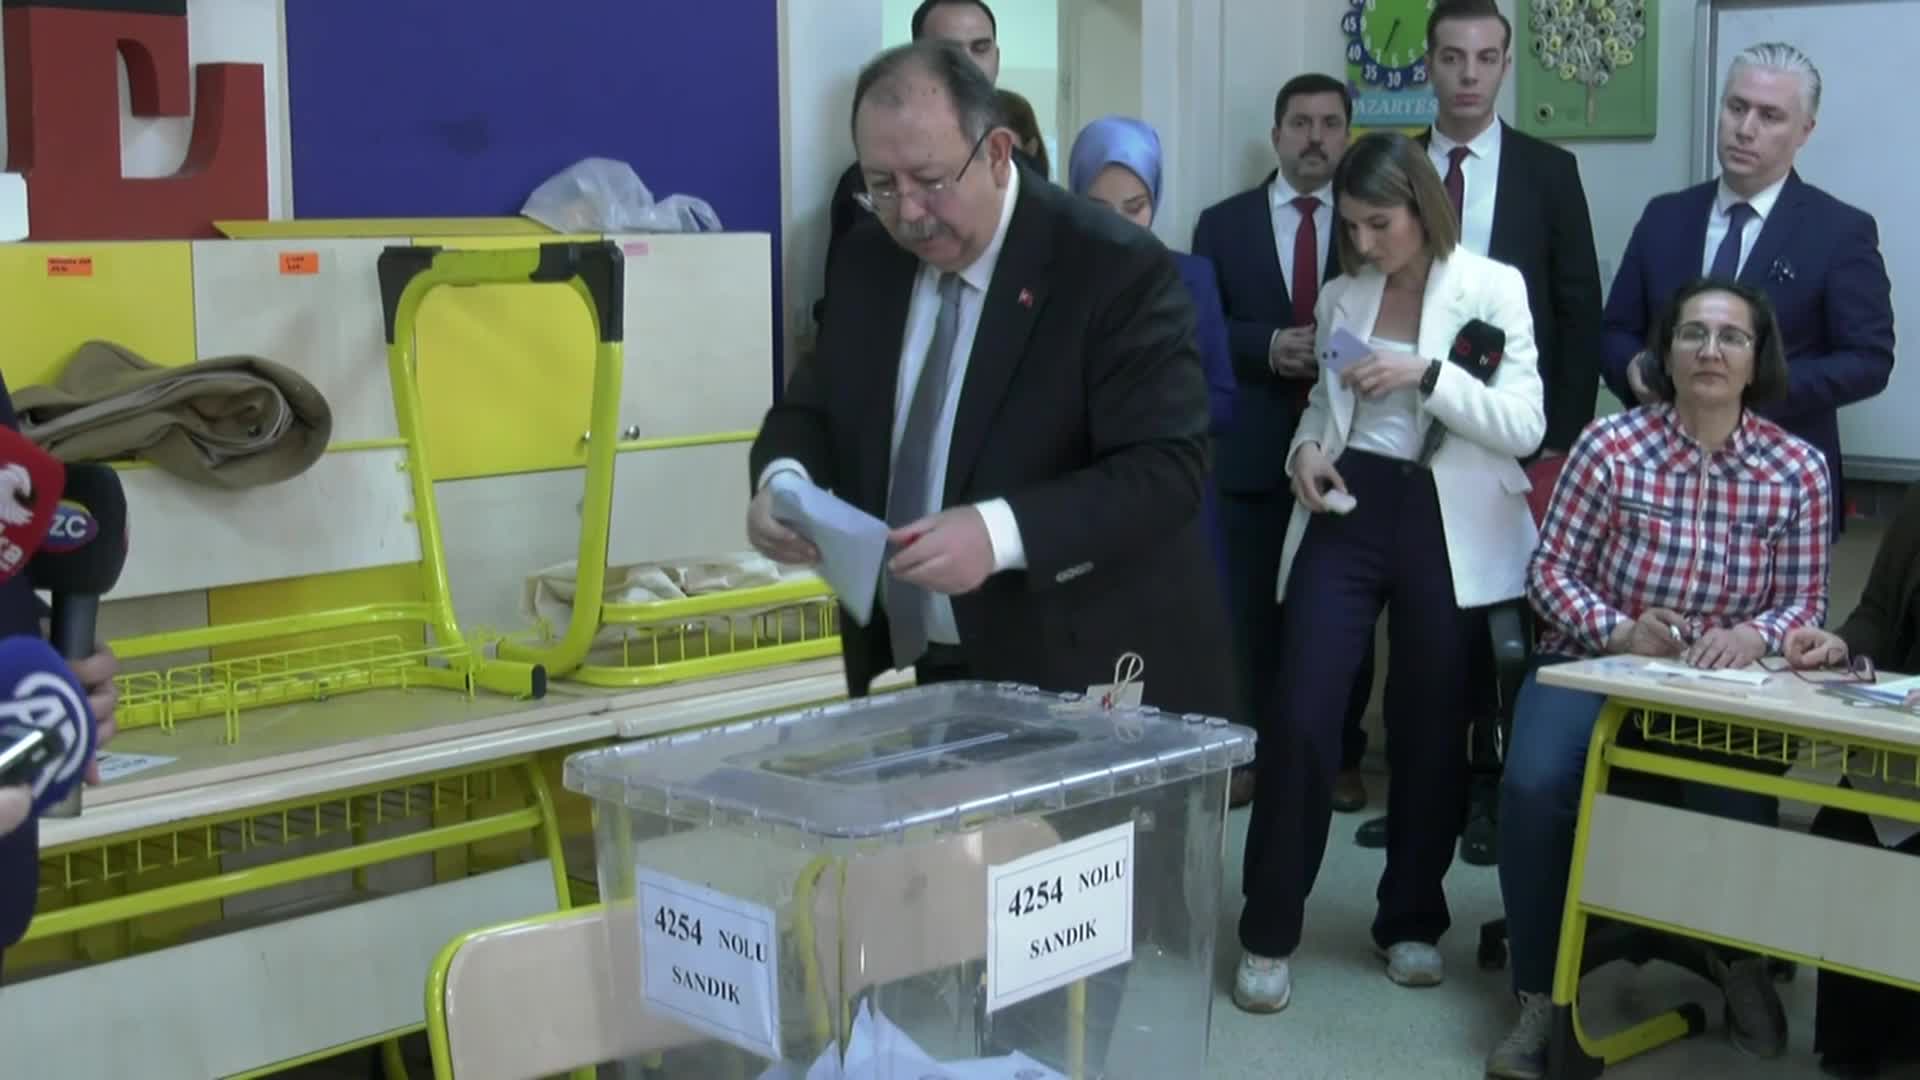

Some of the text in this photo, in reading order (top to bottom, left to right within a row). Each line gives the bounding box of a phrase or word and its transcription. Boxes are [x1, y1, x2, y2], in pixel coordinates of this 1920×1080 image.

[1343, 16, 1357, 32] 45
[1347, 43, 1362, 62] 40
[1364, 64, 1378, 81] 35
[1387, 71, 1402, 89] 30
[1412, 65, 1426, 82] 25
[48, 514, 87, 539] ZC
[1008, 858, 1126, 917] 4254 NOLU
[654, 905, 768, 964] 4254 NOLU
[1029, 918, 1097, 959] SANDIK
[672, 965, 740, 1005] SANDIK
